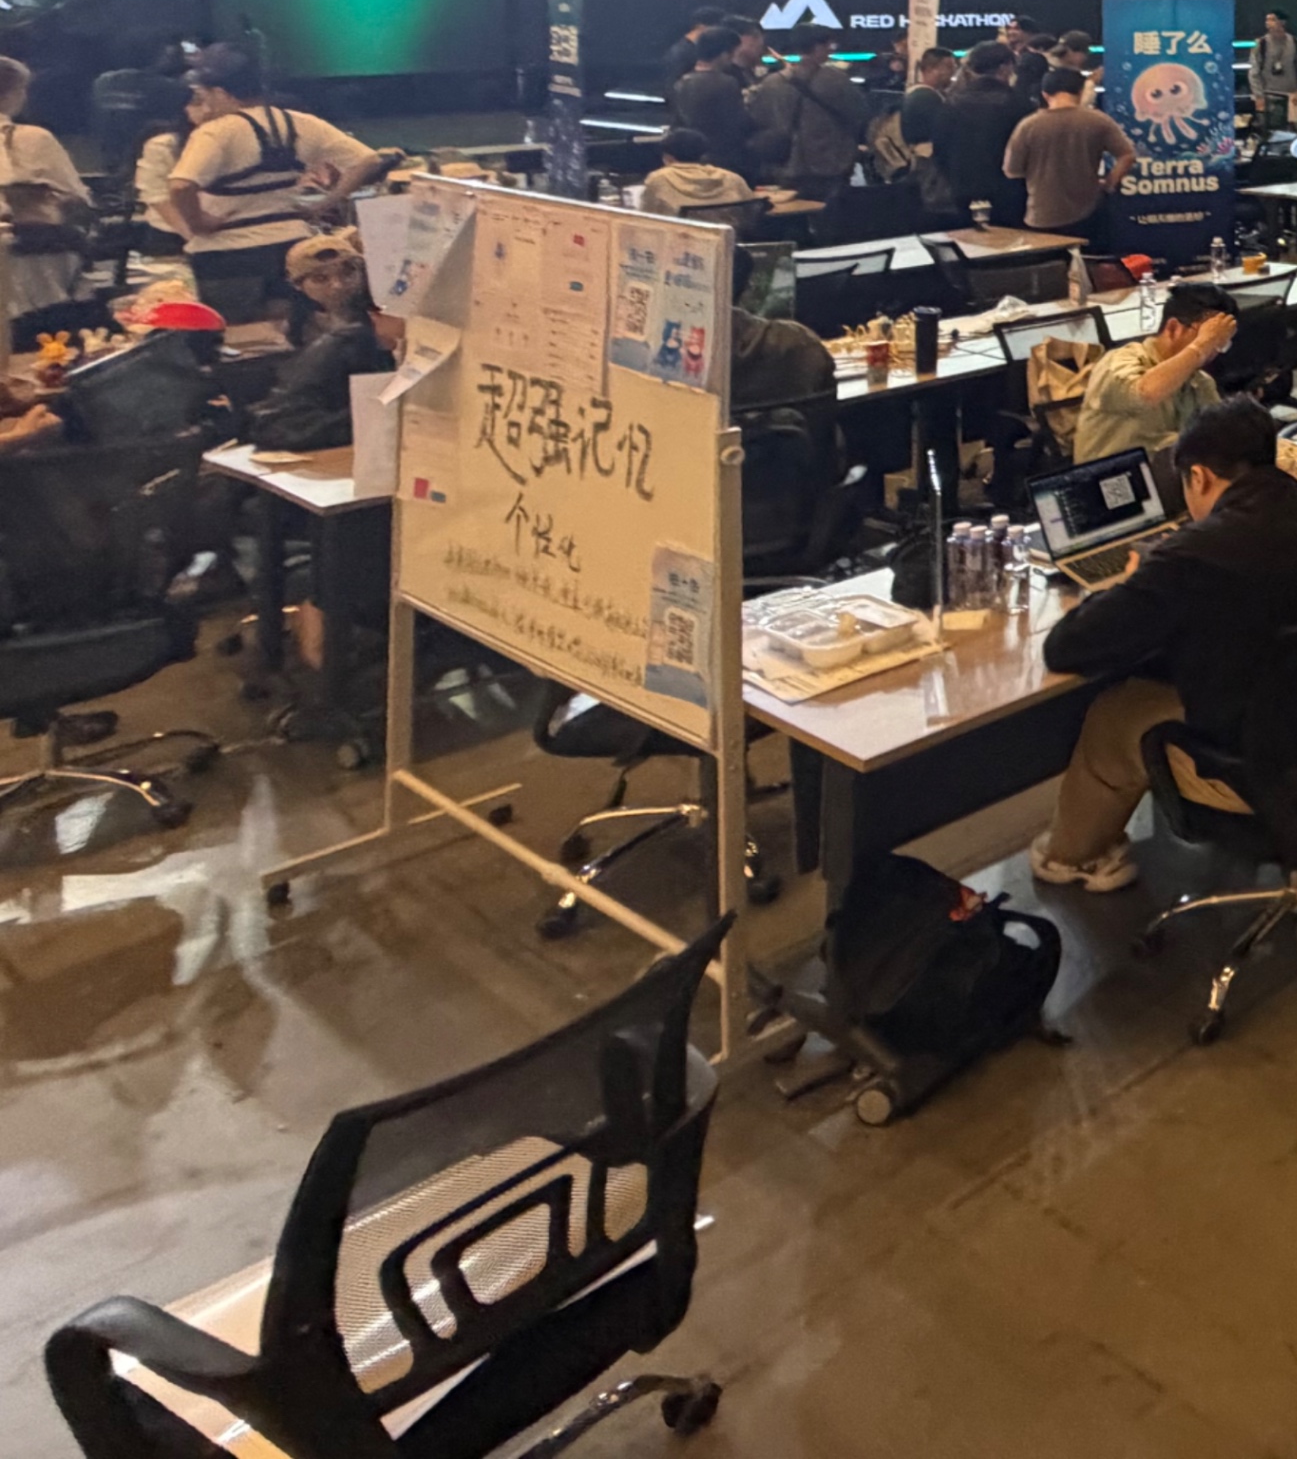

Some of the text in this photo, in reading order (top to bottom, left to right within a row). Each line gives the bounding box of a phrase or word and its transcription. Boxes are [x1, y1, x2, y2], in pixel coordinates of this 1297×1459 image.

[850, 12, 1014, 29] RED HKATHON
[1133, 31, 1213, 56] 睡了么
[1136, 156, 1204, 176] Terra
[1120, 175, 1219, 196] Somnus
[475, 363, 654, 503] 超强记忆
[504, 492, 581, 573] 个性化
